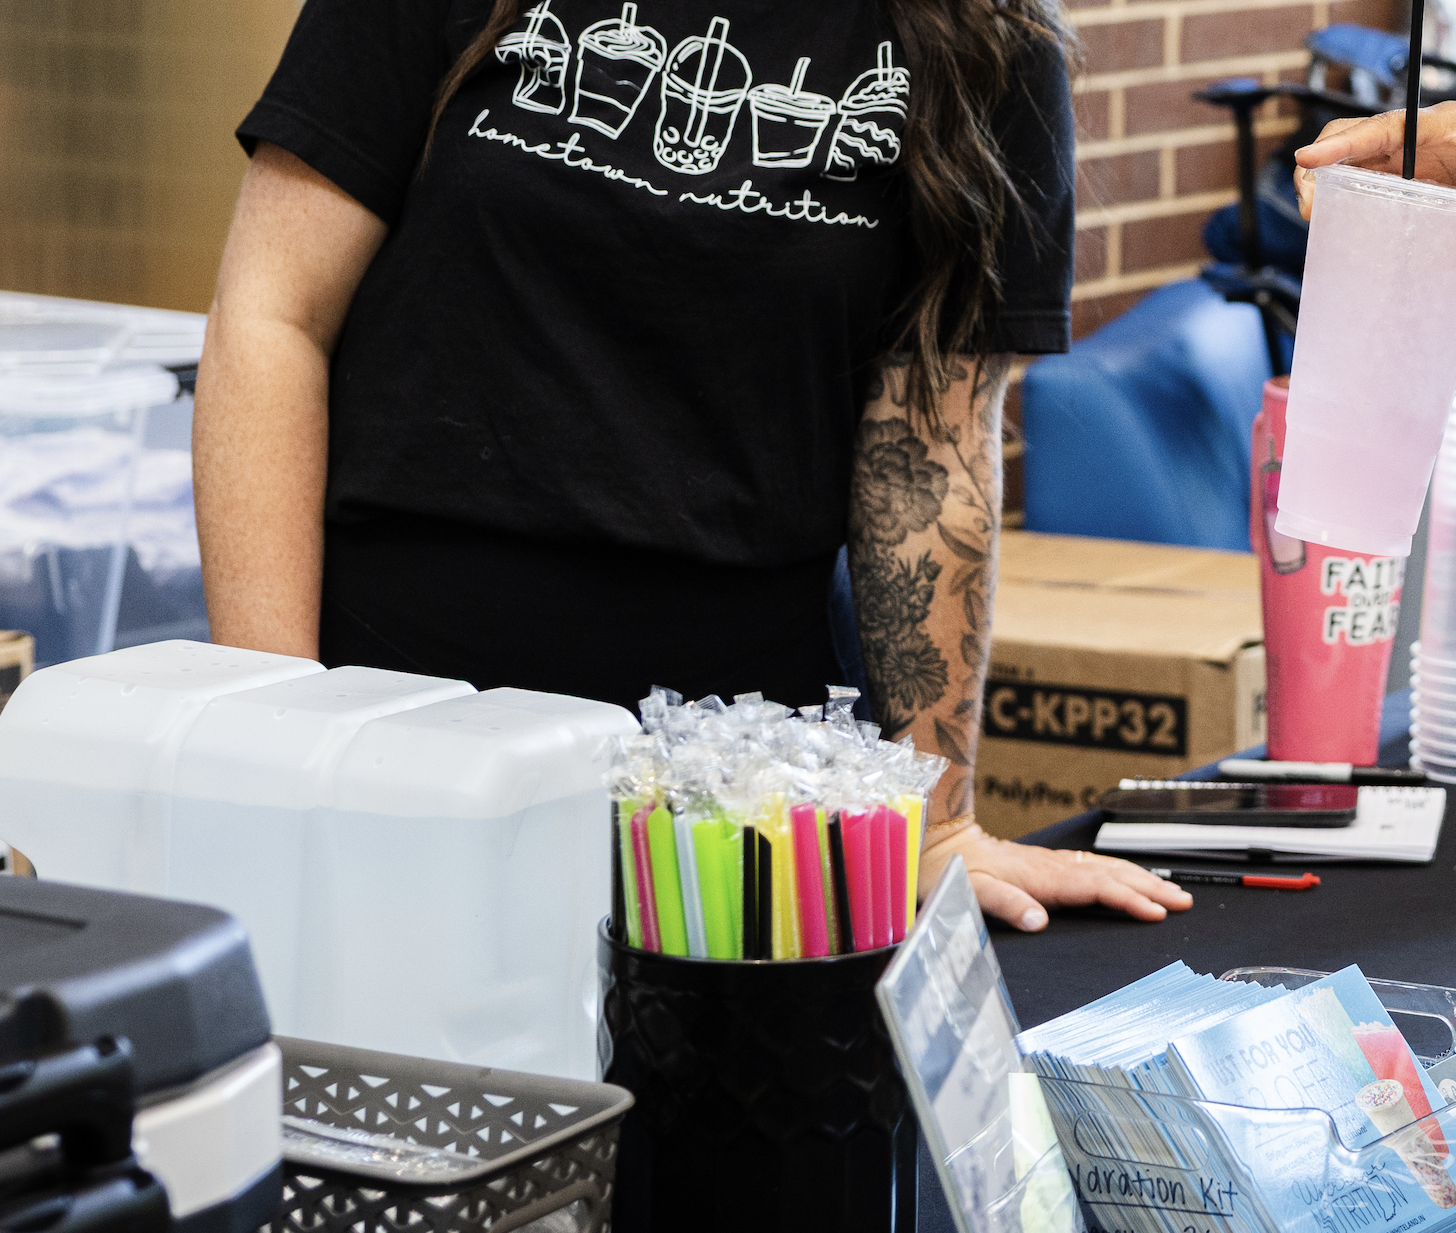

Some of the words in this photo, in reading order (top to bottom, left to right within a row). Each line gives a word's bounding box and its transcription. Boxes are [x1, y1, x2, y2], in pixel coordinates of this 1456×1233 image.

[468, 109, 668, 197] hometown
[679, 179, 879, 229] nutrition
[1326, 560, 1401, 589] FAIT
[989, 687, 1179, 747] C-KPP32
[1239, 1039, 1281, 1075] FOR
[1274, 1022, 1318, 1058] YOU
[1067, 1164, 1186, 1205] ydration
[1200, 1177, 1238, 1210] Kit
